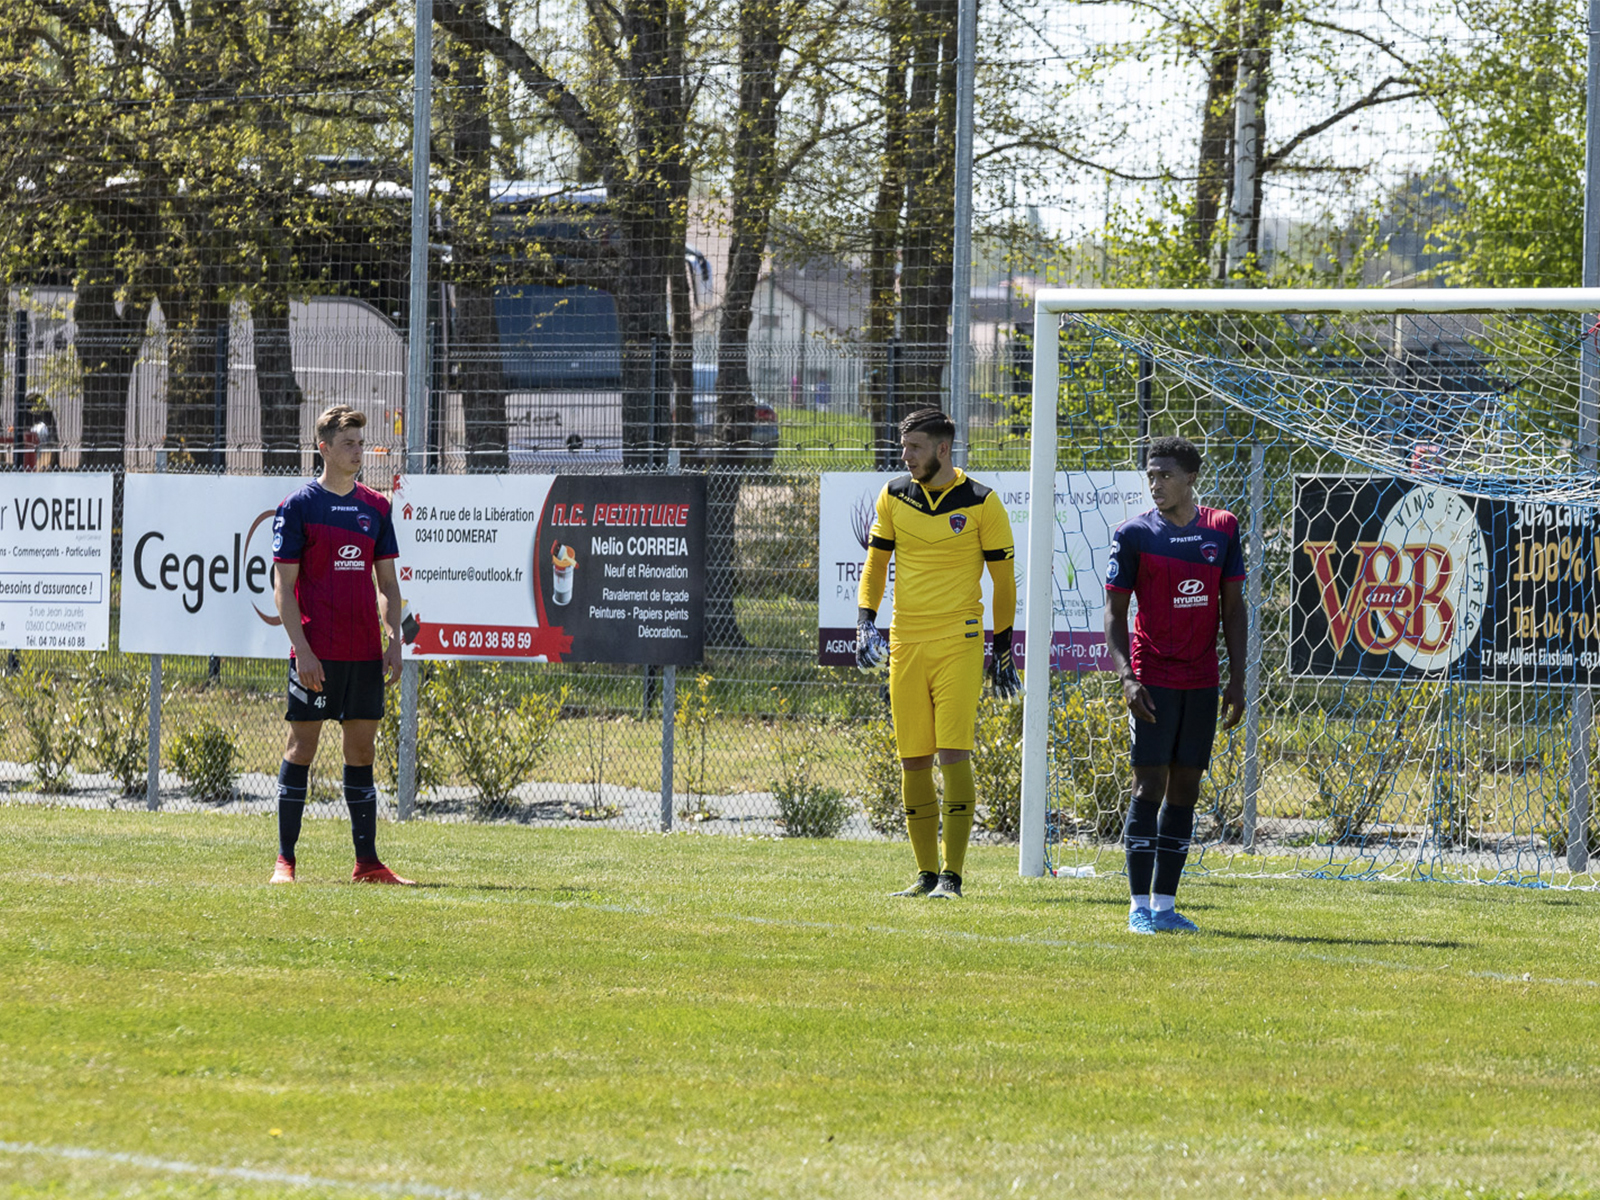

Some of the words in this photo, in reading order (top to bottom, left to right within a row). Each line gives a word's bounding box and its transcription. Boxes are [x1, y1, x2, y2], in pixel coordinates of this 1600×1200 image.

[1003, 492, 1023, 504] UNE
[1086, 492, 1119, 505] SAVOIR
[14, 497, 102, 531] VORELLI
[416, 507, 428, 521] 26
[430, 507, 437, 521] A
[440, 509, 456, 521] rue
[458, 507, 470, 521] de
[473, 507, 482, 521] la
[485, 507, 534, 522] Libération
[1394, 492, 1434, 527] VINS
[415, 528, 444, 542] 03410
[446, 529, 498, 543] DOMERAT
[12, 546, 59, 559] Commerçants
[65, 546, 101, 557] Particuliers
[591, 536, 624, 556] Nelio
[627, 537, 689, 556] CORREIA
[1513, 536, 1586, 582] 100%
[133, 531, 275, 614] Cegele
[415, 566, 523, 583] ncpeinture@outlook.fr
[604, 563, 626, 578] Neuf
[627, 564, 636, 578] et
[638, 563, 688, 579] Rénovation
[0, 581, 31, 594] besoins
[34, 581, 87, 595] d'assurance
[1366, 588, 1406, 603] and
[602, 588, 648, 601] Ravalement
[649, 589, 661, 602] de
[662, 588, 690, 605] façade
[1173, 595, 1208, 604] HYUNDAI
[29, 606, 34, 617] 5
[34, 608, 45, 617] rue
[47, 606, 62, 617] Jean
[64, 606, 84, 617] Jaurès
[589, 605, 626, 619] Peintures
[633, 606, 663, 622] Papiers
[664, 607, 689, 622] peints
[25, 620, 44, 631] 03600
[45, 621, 87, 631] COMMENTRY
[638, 625, 688, 639] Décoration...
[26, 635, 37, 646] Tél.
[39, 636, 47, 646] 04
[49, 636, 57, 646] 70
[58, 636, 66, 646] 64
[67, 636, 76, 646] 60
[77, 636, 86, 647] 88
[453, 631, 467, 648] 06
[469, 631, 483, 648] 20
[485, 631, 499, 648] 38
[501, 631, 515, 649] 58
[517, 632, 532, 649] 59
[825, 640, 857, 653] AGENC
[1088, 644, 1112, 658] 047
[1481, 648, 1492, 666] 17
[1538, 648, 1573, 666] Einstein
[1580, 650, 1600, 668] 031
